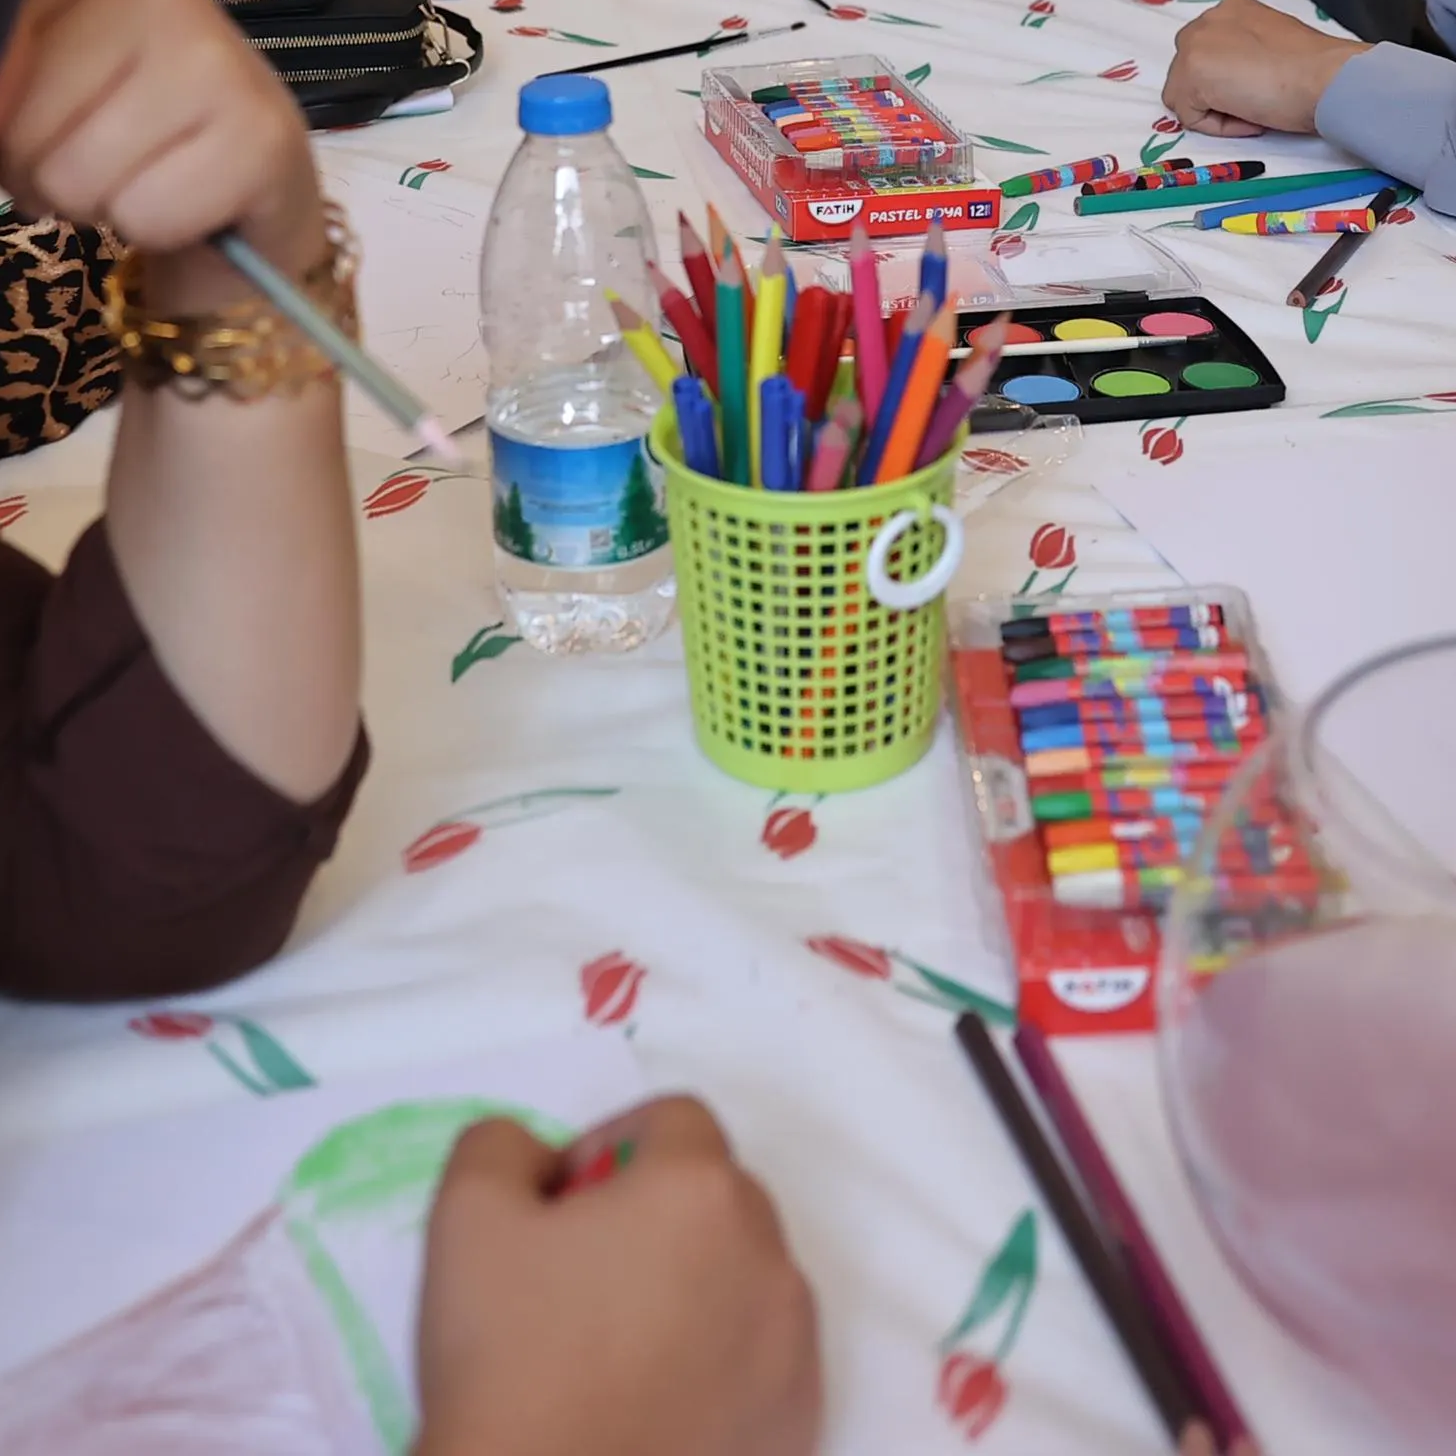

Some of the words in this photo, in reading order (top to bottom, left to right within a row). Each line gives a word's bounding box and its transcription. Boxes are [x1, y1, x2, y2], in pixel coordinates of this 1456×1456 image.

[869, 209, 922, 223] PASTEL
[925, 206, 962, 220] BOYA
[969, 204, 985, 217] 12
